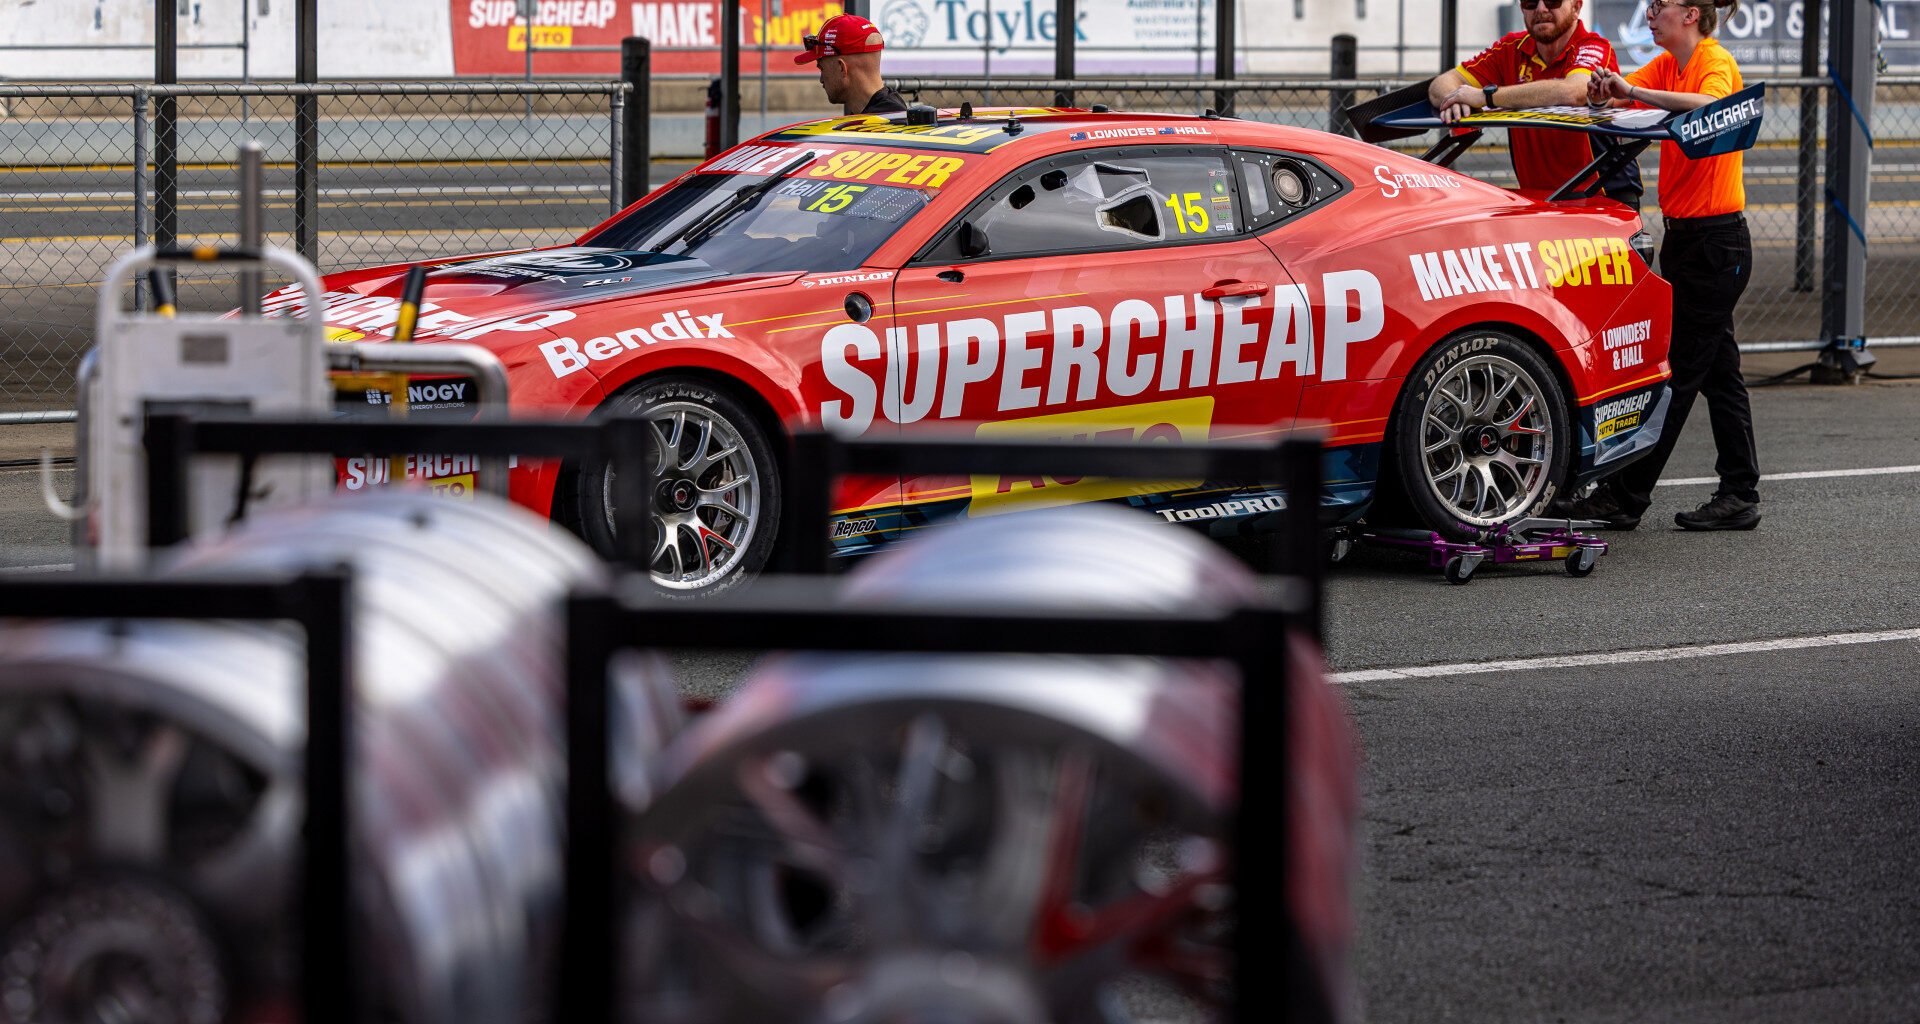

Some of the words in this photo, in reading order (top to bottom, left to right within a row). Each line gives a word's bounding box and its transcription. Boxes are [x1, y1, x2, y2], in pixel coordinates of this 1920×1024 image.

[631, 2, 715, 46] MAKE
[1087, 127, 1156, 140] LOWNDES
[1174, 127, 1211, 135] HALL
[808, 150, 965, 188] SUPER
[776, 179, 831, 198] Hall
[806, 183, 869, 213] 15
[1165, 192, 1209, 234] 15
[818, 272, 894, 286] DUNLOP
[1409, 245, 1513, 301] MAKE
[1502, 242, 1539, 290] IT
[1538, 237, 1633, 288] SUPER
[538, 309, 735, 379] Bendix
[1602, 319, 1651, 351] LOWNDESY
[821, 269, 1385, 439] SUPERCHEAP
[1424, 337, 1499, 389] DUNLOP
[1612, 350, 1621, 371] &
[1620, 344, 1644, 369] HALL
[384, 382, 466, 404] NOGY
[1594, 391, 1652, 428] SUPERCHEAP
[1598, 422, 1614, 436] AUTO
[1616, 416, 1638, 430] TRADE
[1156, 496, 1288, 522] ToolPRO
[834, 519, 876, 538] Repco
